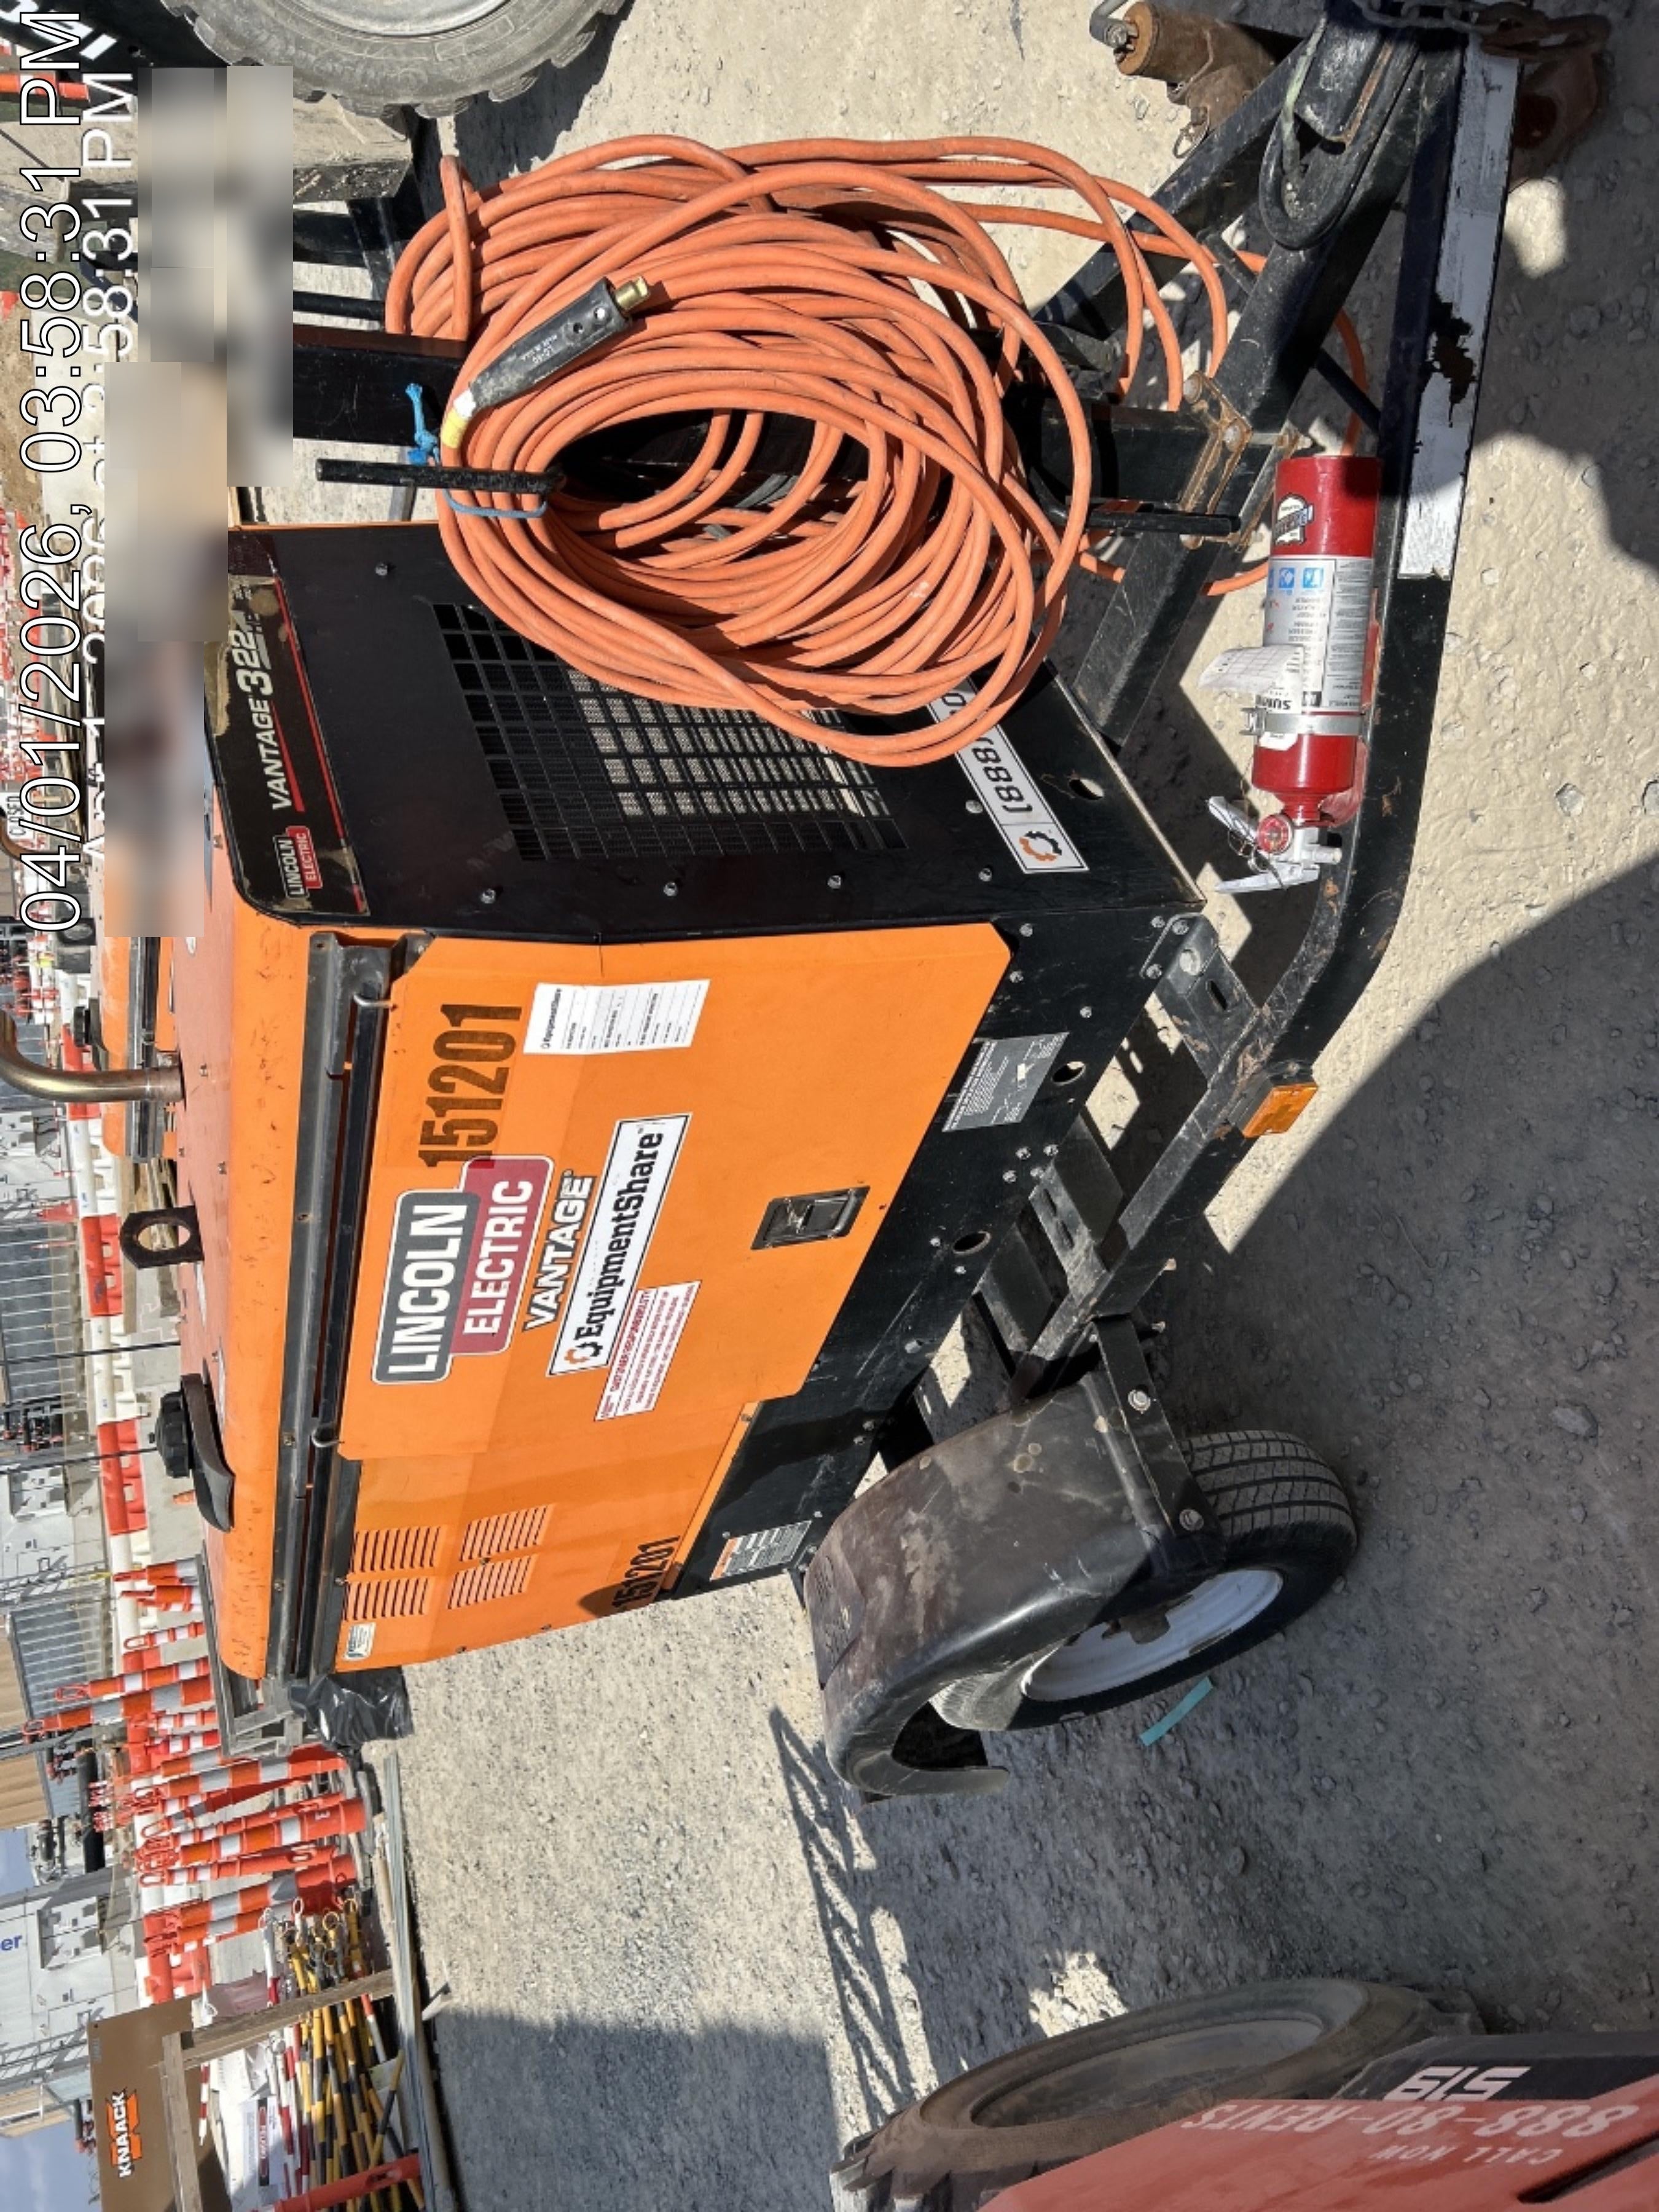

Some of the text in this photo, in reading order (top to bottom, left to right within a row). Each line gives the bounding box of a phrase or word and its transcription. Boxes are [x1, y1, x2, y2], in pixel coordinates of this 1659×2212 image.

[248, 697, 292, 811] VANTAGE
[971, 736, 1033, 814] (888)
[278, 838, 305, 895] LINCOLN
[295, 831, 318, 882] ELECTRIC
[418, 1003, 523, 1167] 151201
[463, 1180, 533, 1335] ELECTRIC
[522, 1174, 595, 1332] VANTAGE
[575, 1132, 664, 1341] EquipmentShare
[387, 1204, 468, 1375] LINCOLN
[611, 1535, 680, 1608] 151201
[112, 2092, 132, 2178] KNAACK
[1180, 2103, 1641, 2139] 888-80-RENTS
[1369, 2144, 1563, 2165] CALL NOW
